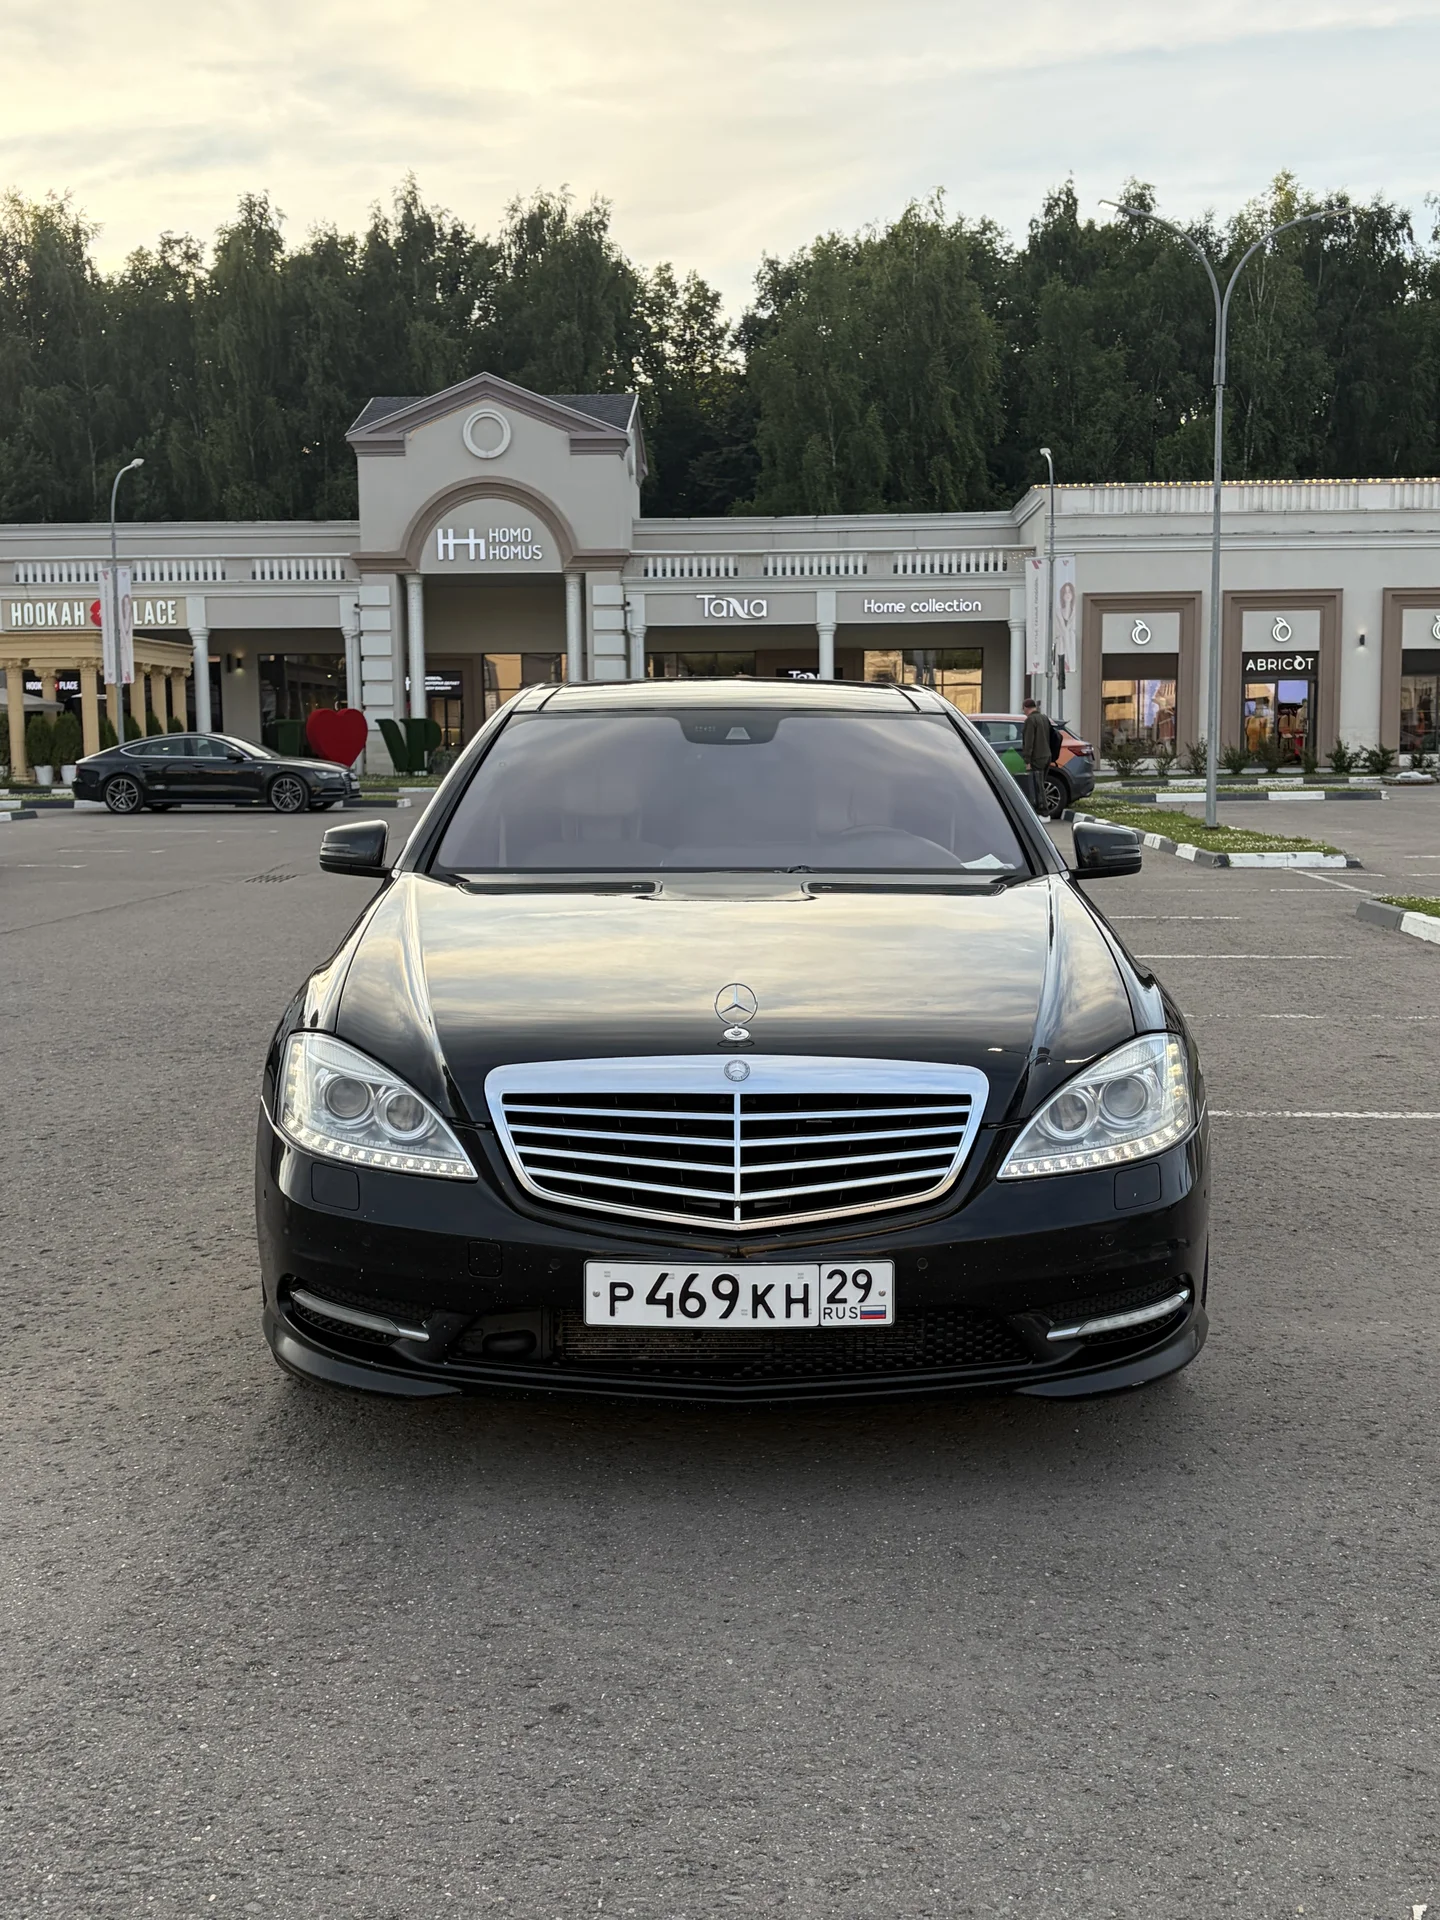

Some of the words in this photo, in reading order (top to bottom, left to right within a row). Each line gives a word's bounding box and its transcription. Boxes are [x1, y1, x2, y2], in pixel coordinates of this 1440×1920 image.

[488, 527, 532, 543] HOMO
[489, 545, 543, 560] HOMUS
[11, 602, 86, 626] HOOKAH
[132, 600, 178, 625] LACE
[864, 599, 906, 613] Home
[910, 598, 982, 613] collection
[1245, 655, 1315, 671] ABRICOT
[26, 681, 43, 690] HOOK
[59, 681, 79, 690] PLACE
[826, 1268, 873, 1304] 29
[823, 1306, 859, 1320] RUS
